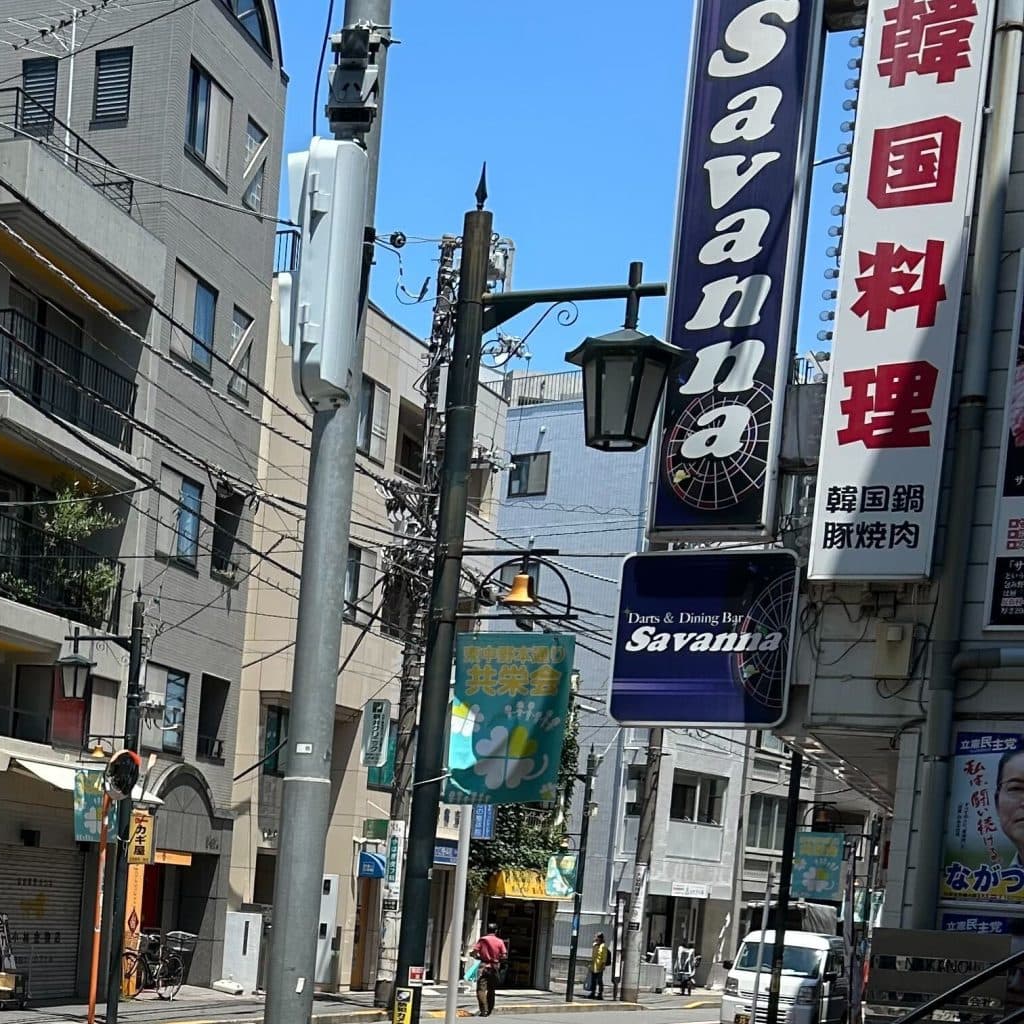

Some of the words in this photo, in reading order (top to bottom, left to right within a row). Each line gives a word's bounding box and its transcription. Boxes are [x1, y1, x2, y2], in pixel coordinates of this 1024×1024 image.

[679, 0, 800, 459] Savanna
[836, 0, 979, 450] 韓国料理
[826, 484, 925, 514] 韓国鍋
[822, 521, 920, 550] 豚焼肉
[628, 612, 660, 624] Darts
[663, 612, 674, 624] &
[679, 612, 719, 626] Dining
[722, 612, 744, 624] Bar
[625, 625, 782, 652] Savanna
[464, 664, 562, 696] 共栄会
[960, 735, 1017, 751] 立憲民主党
[946, 918, 1003, 934] 立憲民主党
